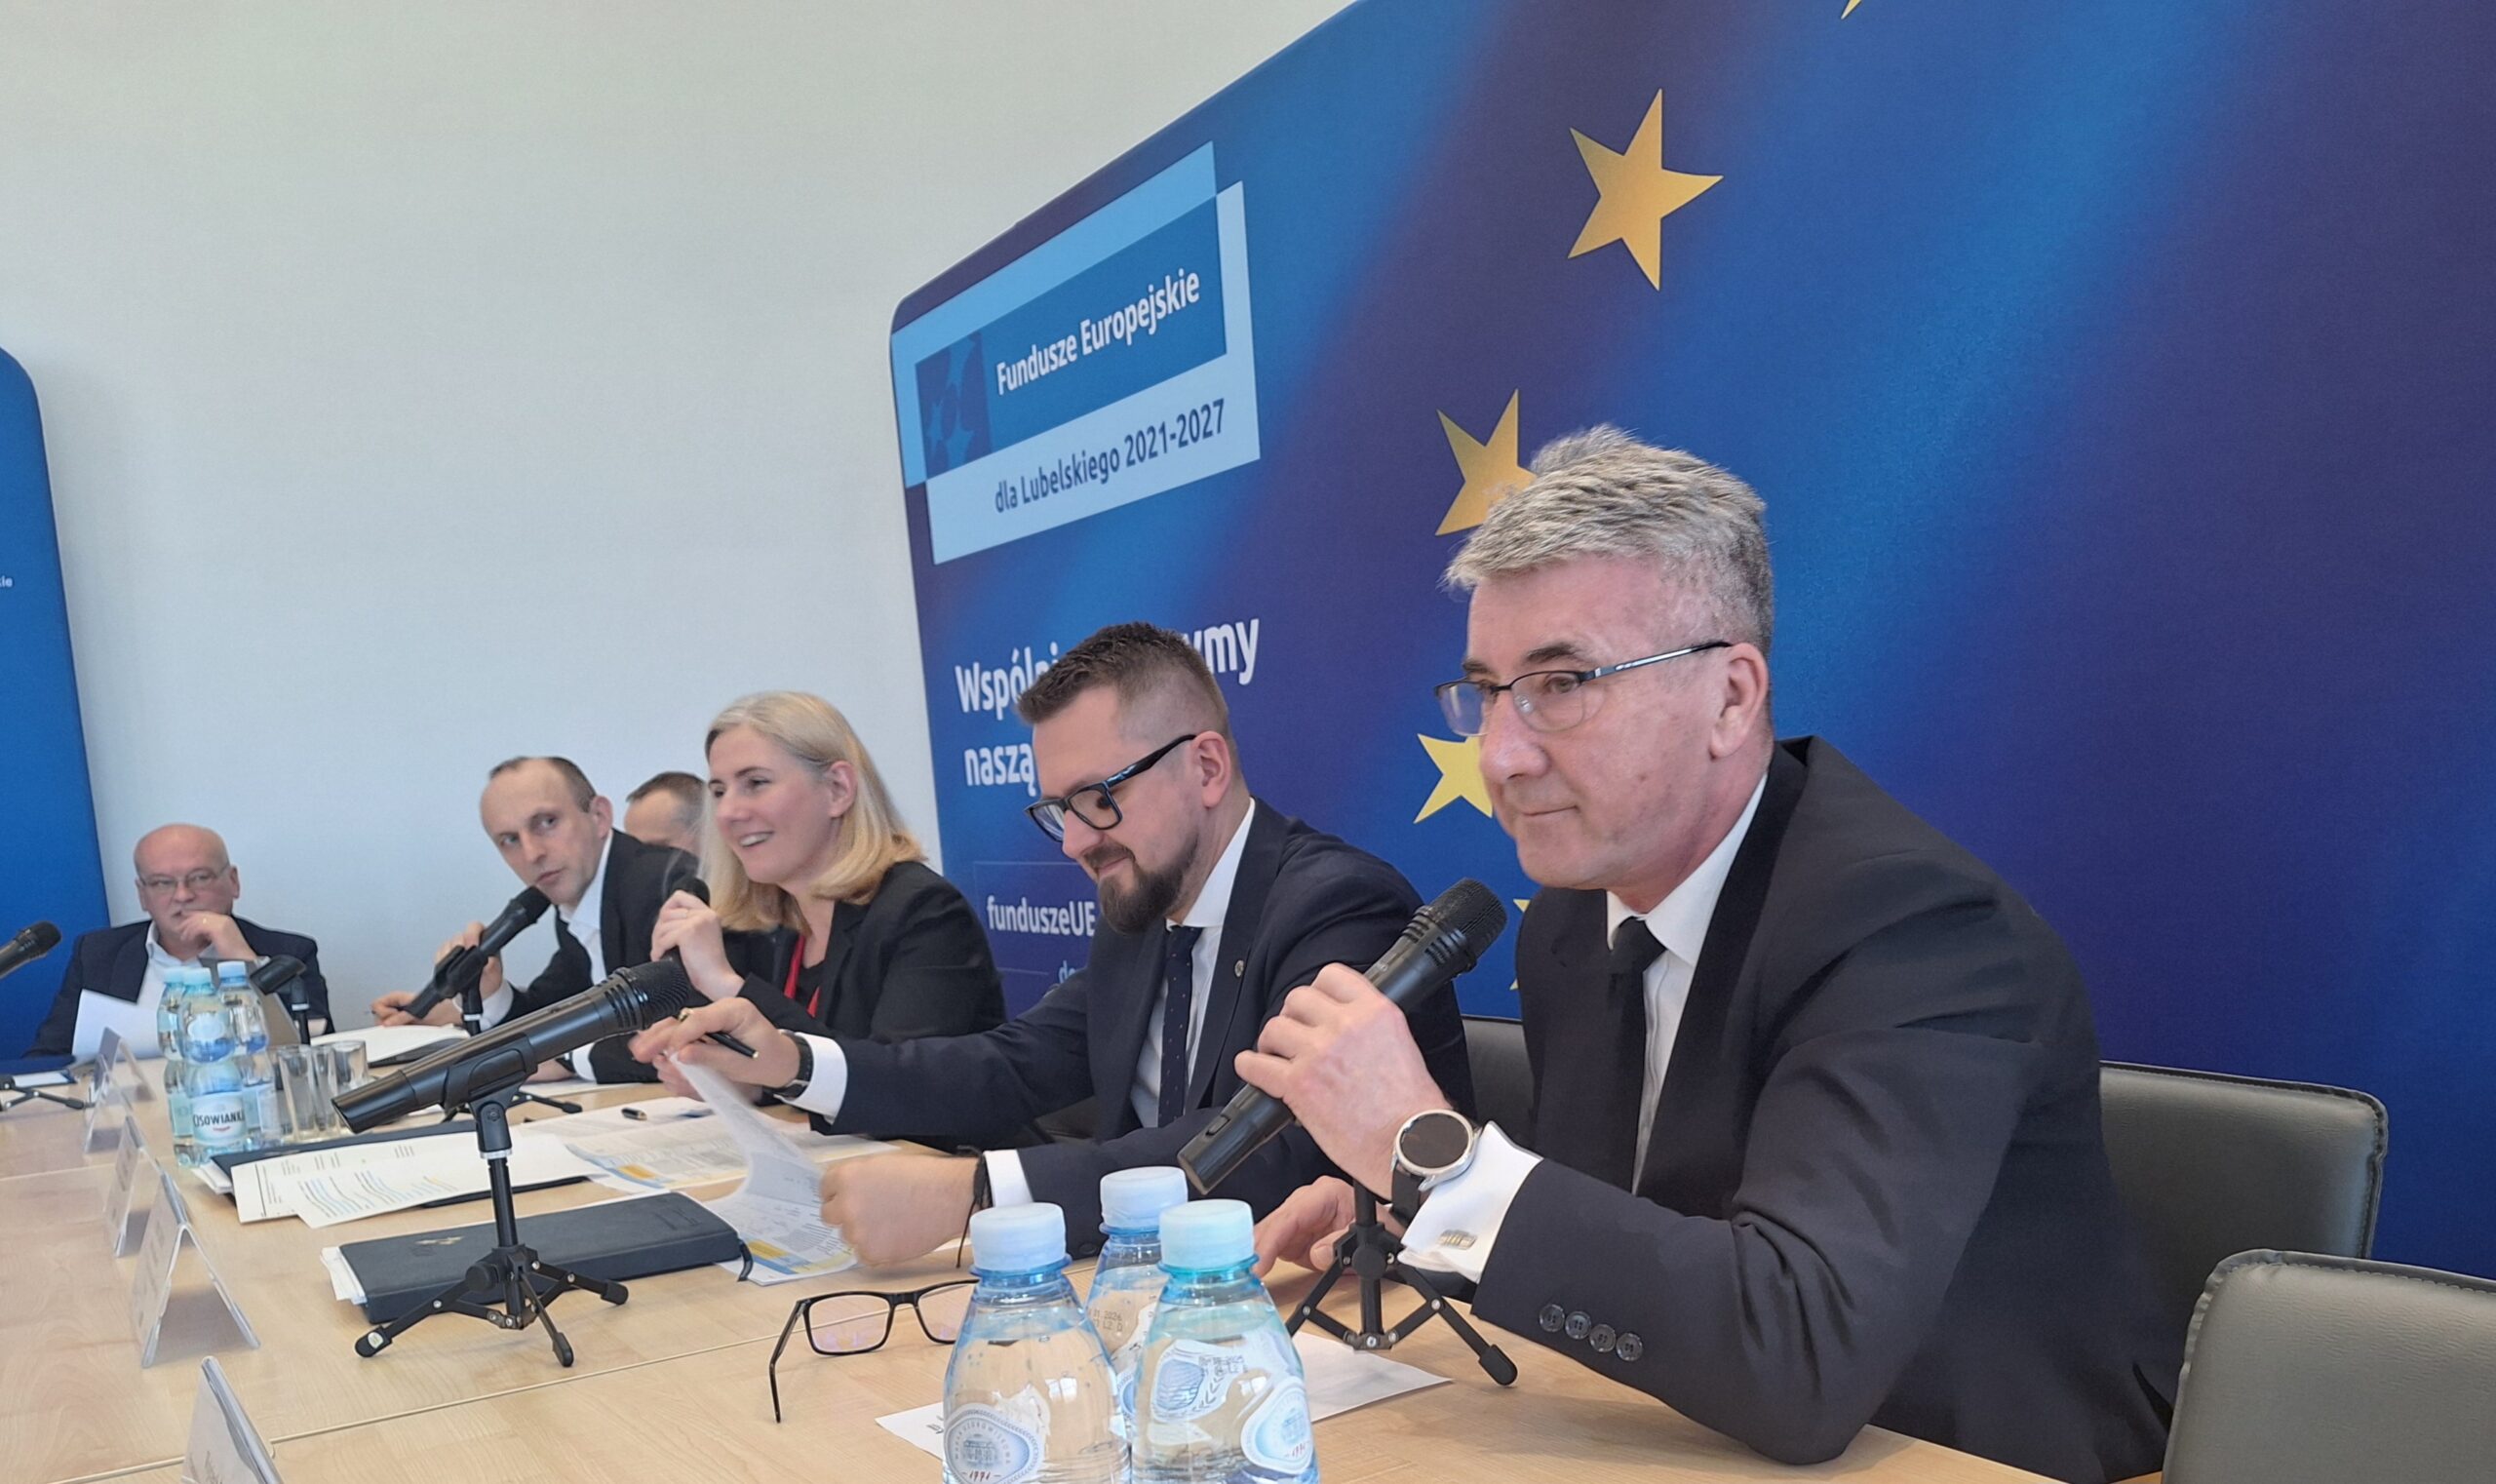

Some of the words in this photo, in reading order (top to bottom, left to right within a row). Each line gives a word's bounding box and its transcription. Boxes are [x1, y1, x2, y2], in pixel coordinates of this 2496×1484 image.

[996, 333, 1077, 396] Fundusze
[1079, 268, 1200, 356] Europejskie
[994, 481, 1018, 514] dla
[1021, 449, 1120, 504] Lubelskiego
[1124, 398, 1225, 468] 2021-2027
[964, 743, 1036, 798] naszą
[987, 895, 1096, 937] funduszeUE
